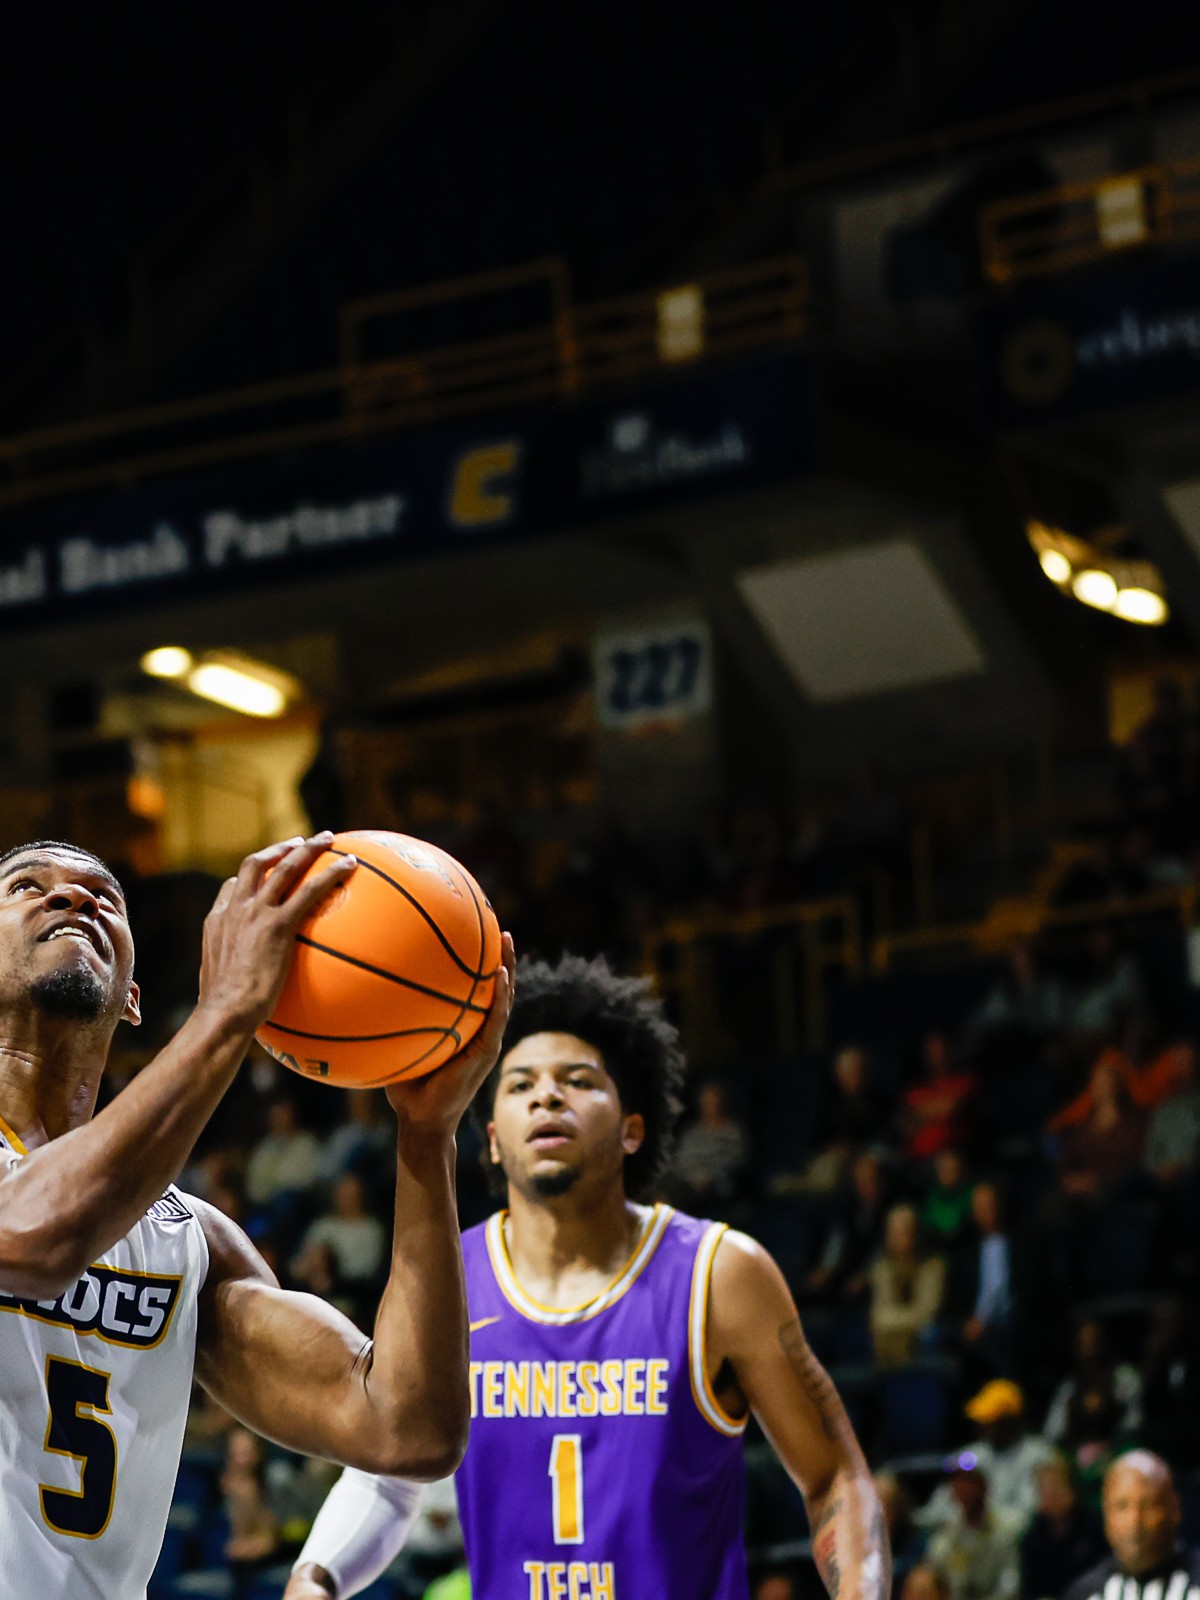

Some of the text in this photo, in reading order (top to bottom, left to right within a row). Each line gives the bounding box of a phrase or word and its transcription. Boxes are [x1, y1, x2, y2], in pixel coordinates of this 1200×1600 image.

[61, 520, 189, 594] Bank
[204, 493, 404, 569] Partner
[609, 637, 701, 713] 227
[469, 1358, 670, 1419] TENNESSEE
[39, 1353, 118, 1540] 5
[547, 1433, 585, 1546] 1
[522, 1560, 616, 1600] TECH
